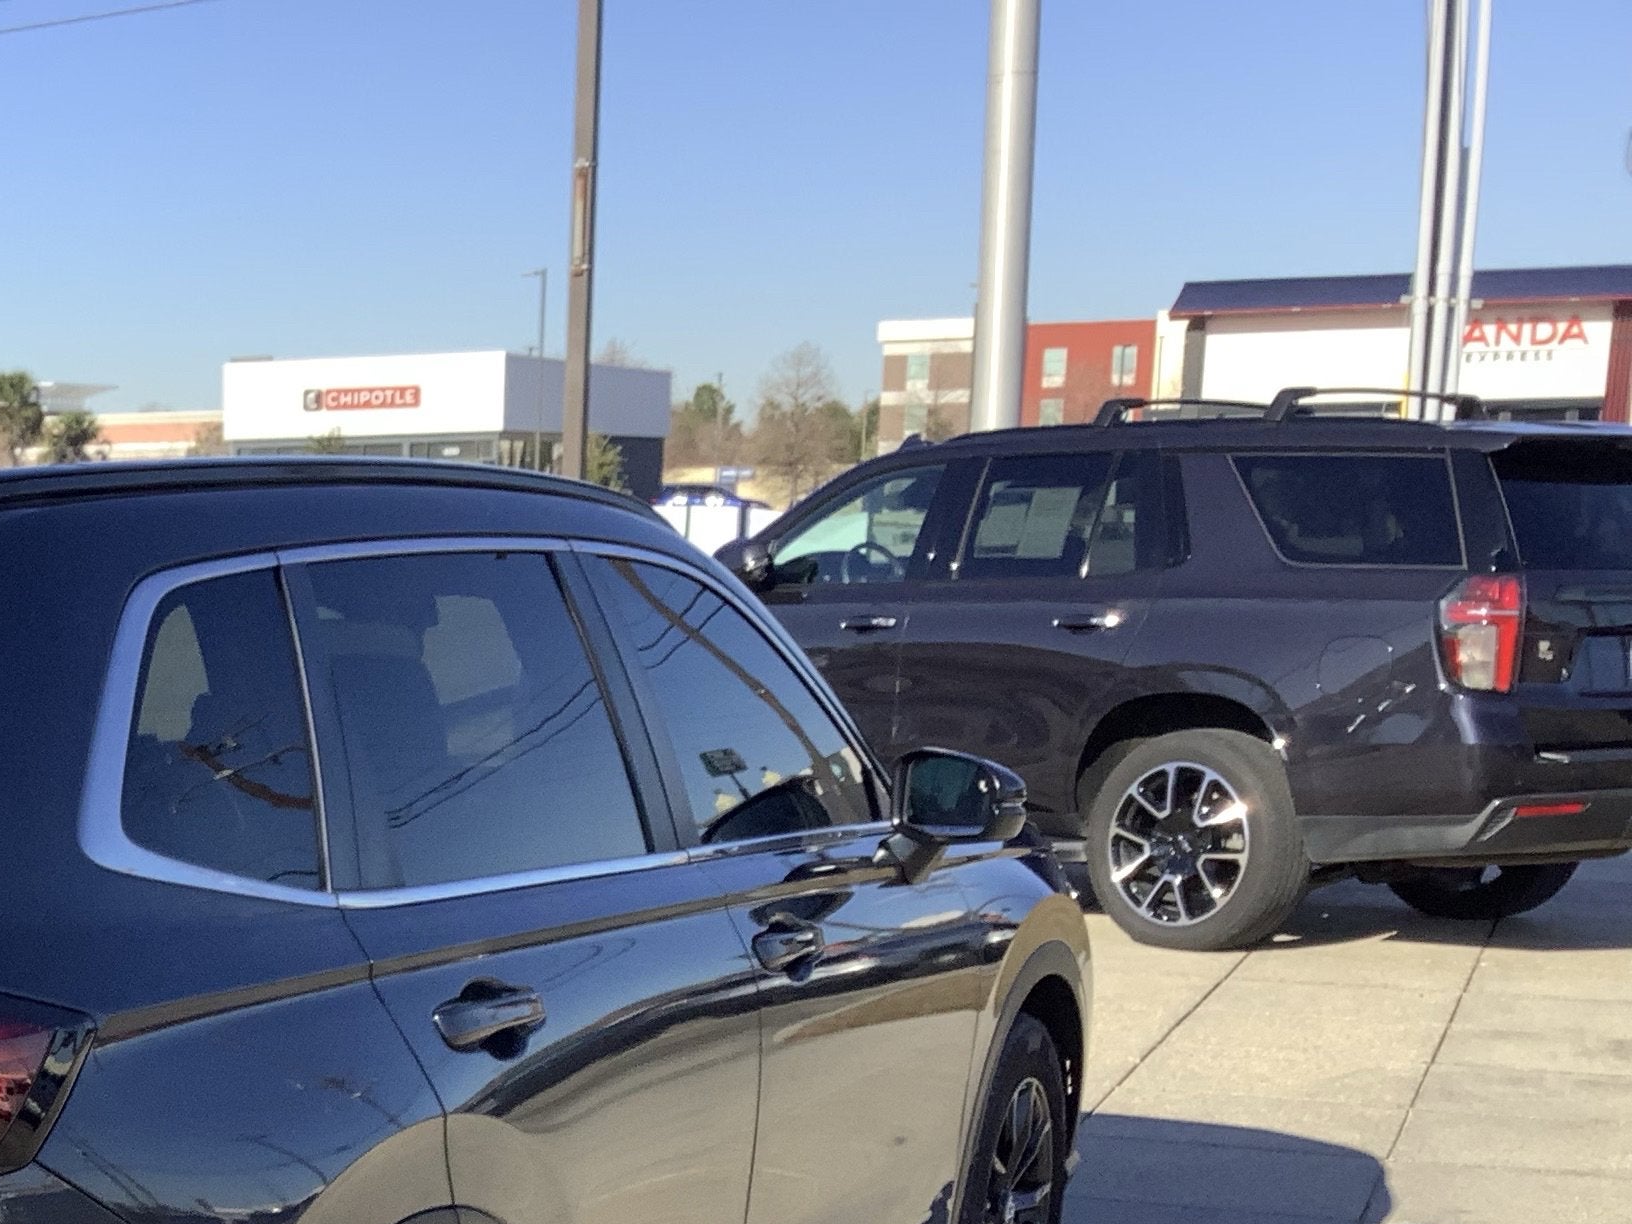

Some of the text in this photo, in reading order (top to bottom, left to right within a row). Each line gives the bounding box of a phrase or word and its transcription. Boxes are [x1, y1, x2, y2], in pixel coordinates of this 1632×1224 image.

[1462, 313, 1589, 347] ANDA
[1465, 349, 1553, 363] EXPRESS
[327, 387, 416, 407] CHIPOTLE
